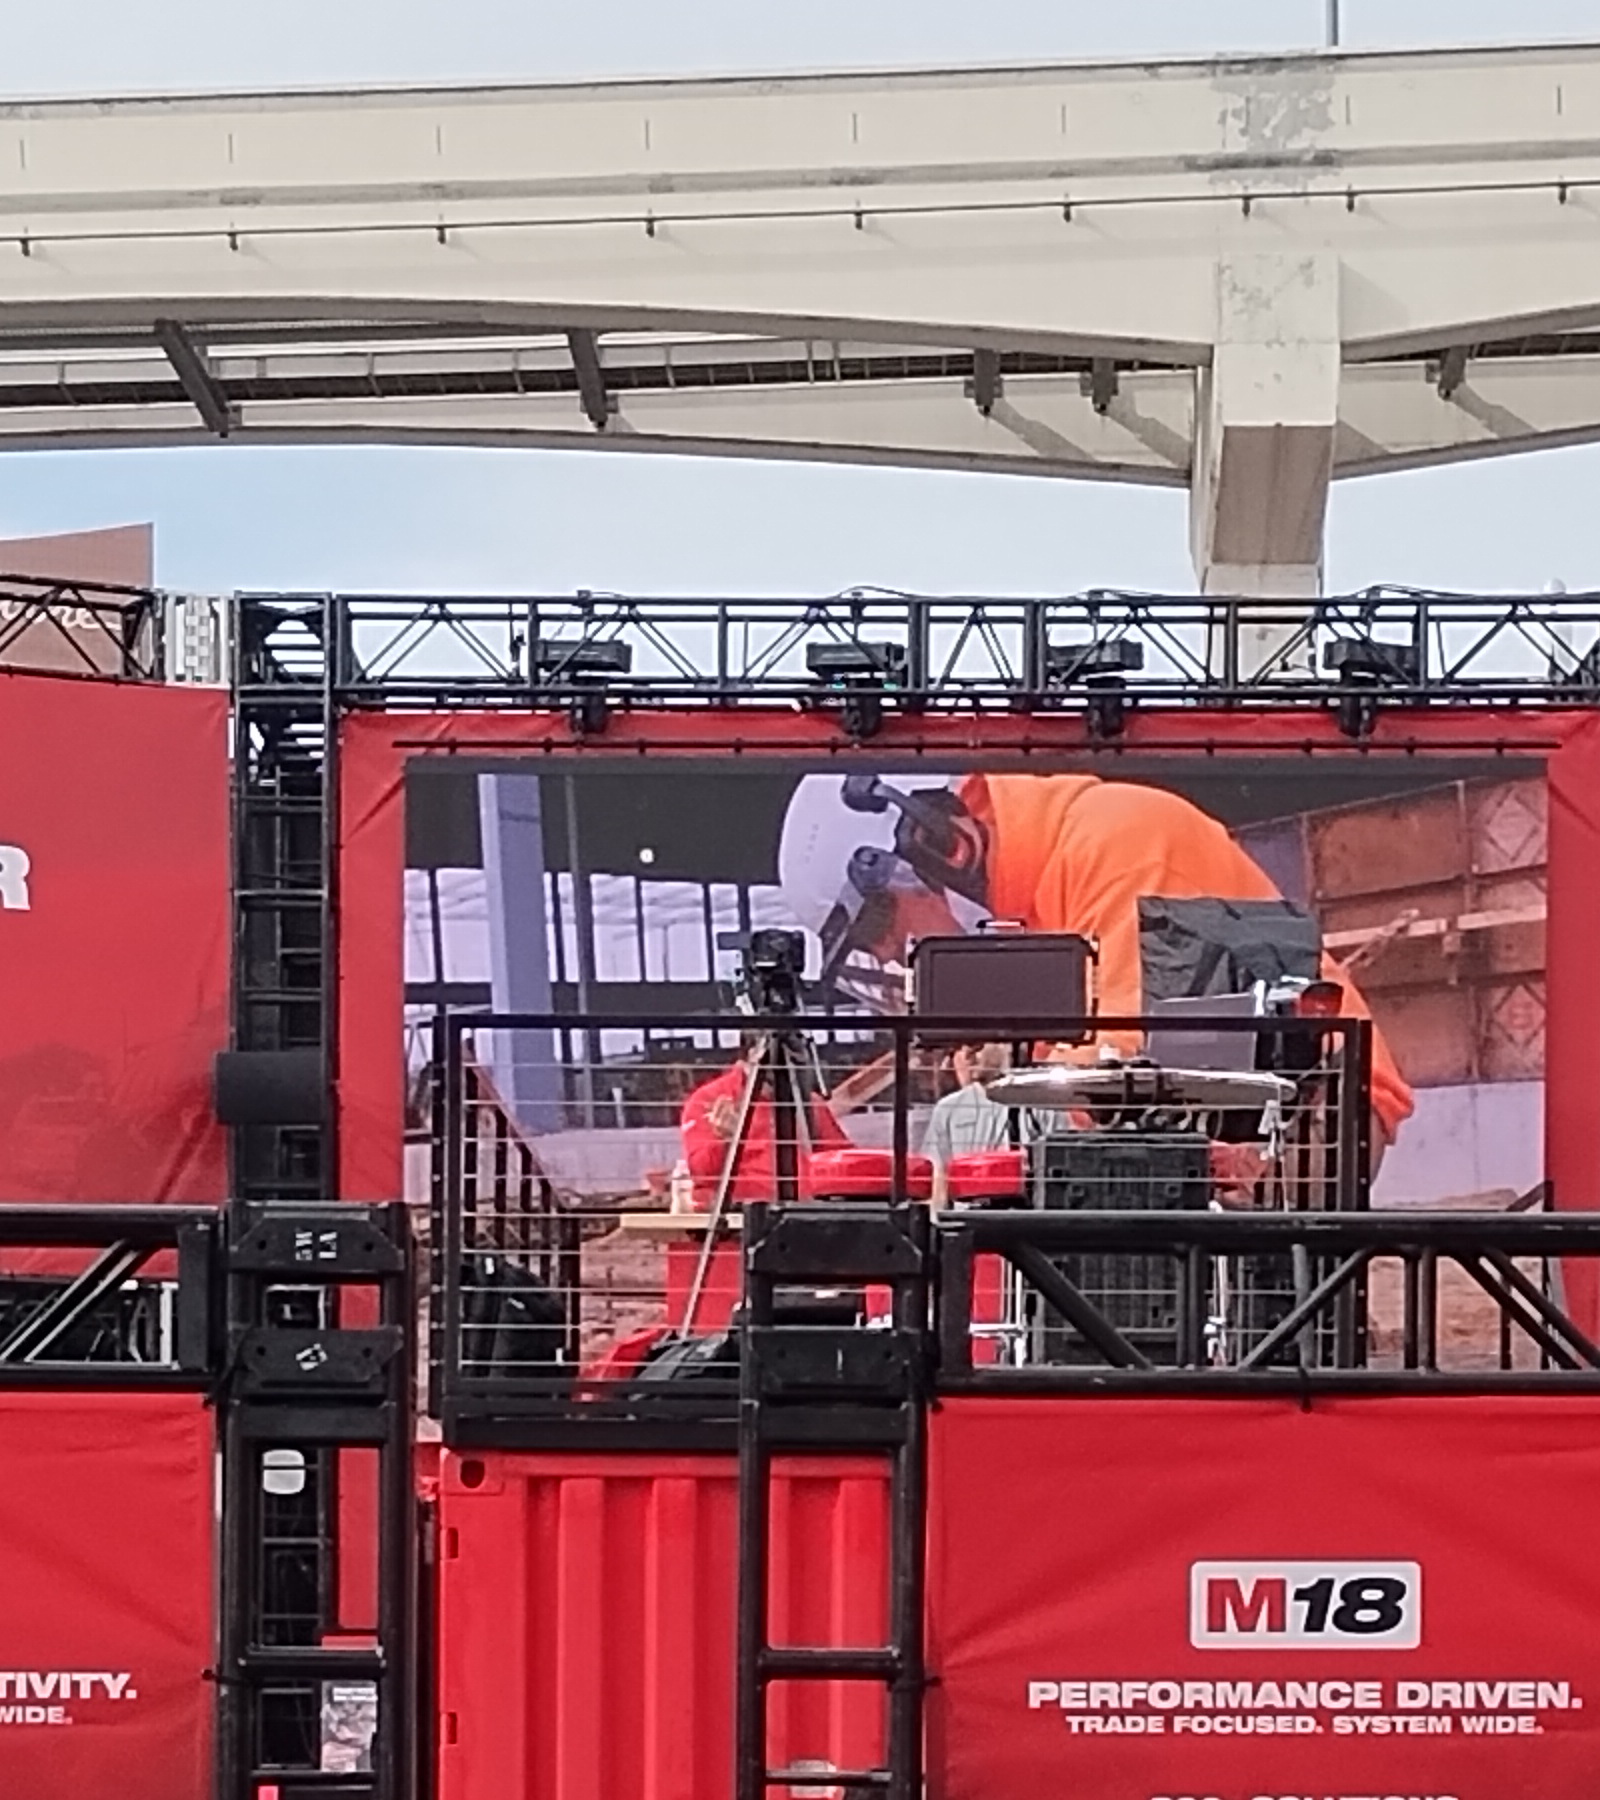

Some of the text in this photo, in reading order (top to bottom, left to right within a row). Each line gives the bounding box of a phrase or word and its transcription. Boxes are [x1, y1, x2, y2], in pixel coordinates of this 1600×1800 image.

[1207, 1577, 1407, 1633] M18
[1029, 1682, 1582, 1708] PERFORMANCE DRIVEN.
[1066, 1716, 1543, 1734] TRADE FOCUSED. SYSTEM WIDE.
